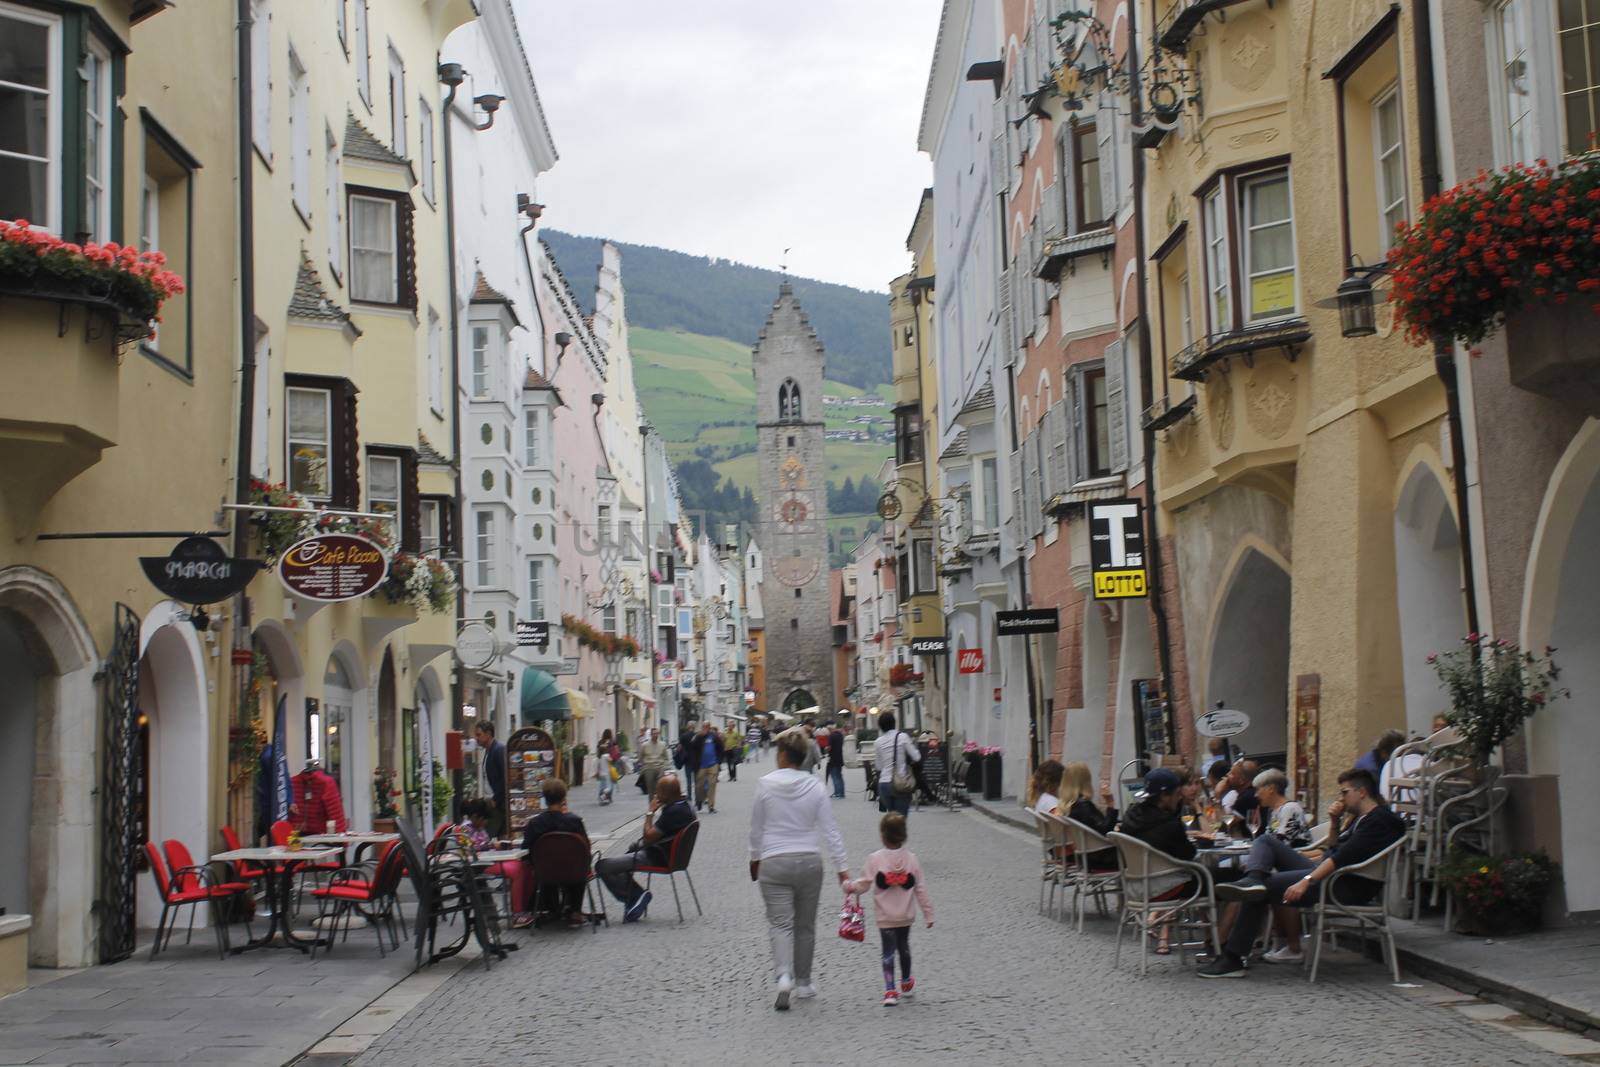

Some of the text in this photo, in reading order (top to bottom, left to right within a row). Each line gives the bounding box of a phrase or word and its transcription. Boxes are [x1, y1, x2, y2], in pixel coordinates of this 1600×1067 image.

[1097, 574, 1143, 595] LOTTO
[912, 641, 945, 651] PLEASE
[960, 652, 983, 671] illy
